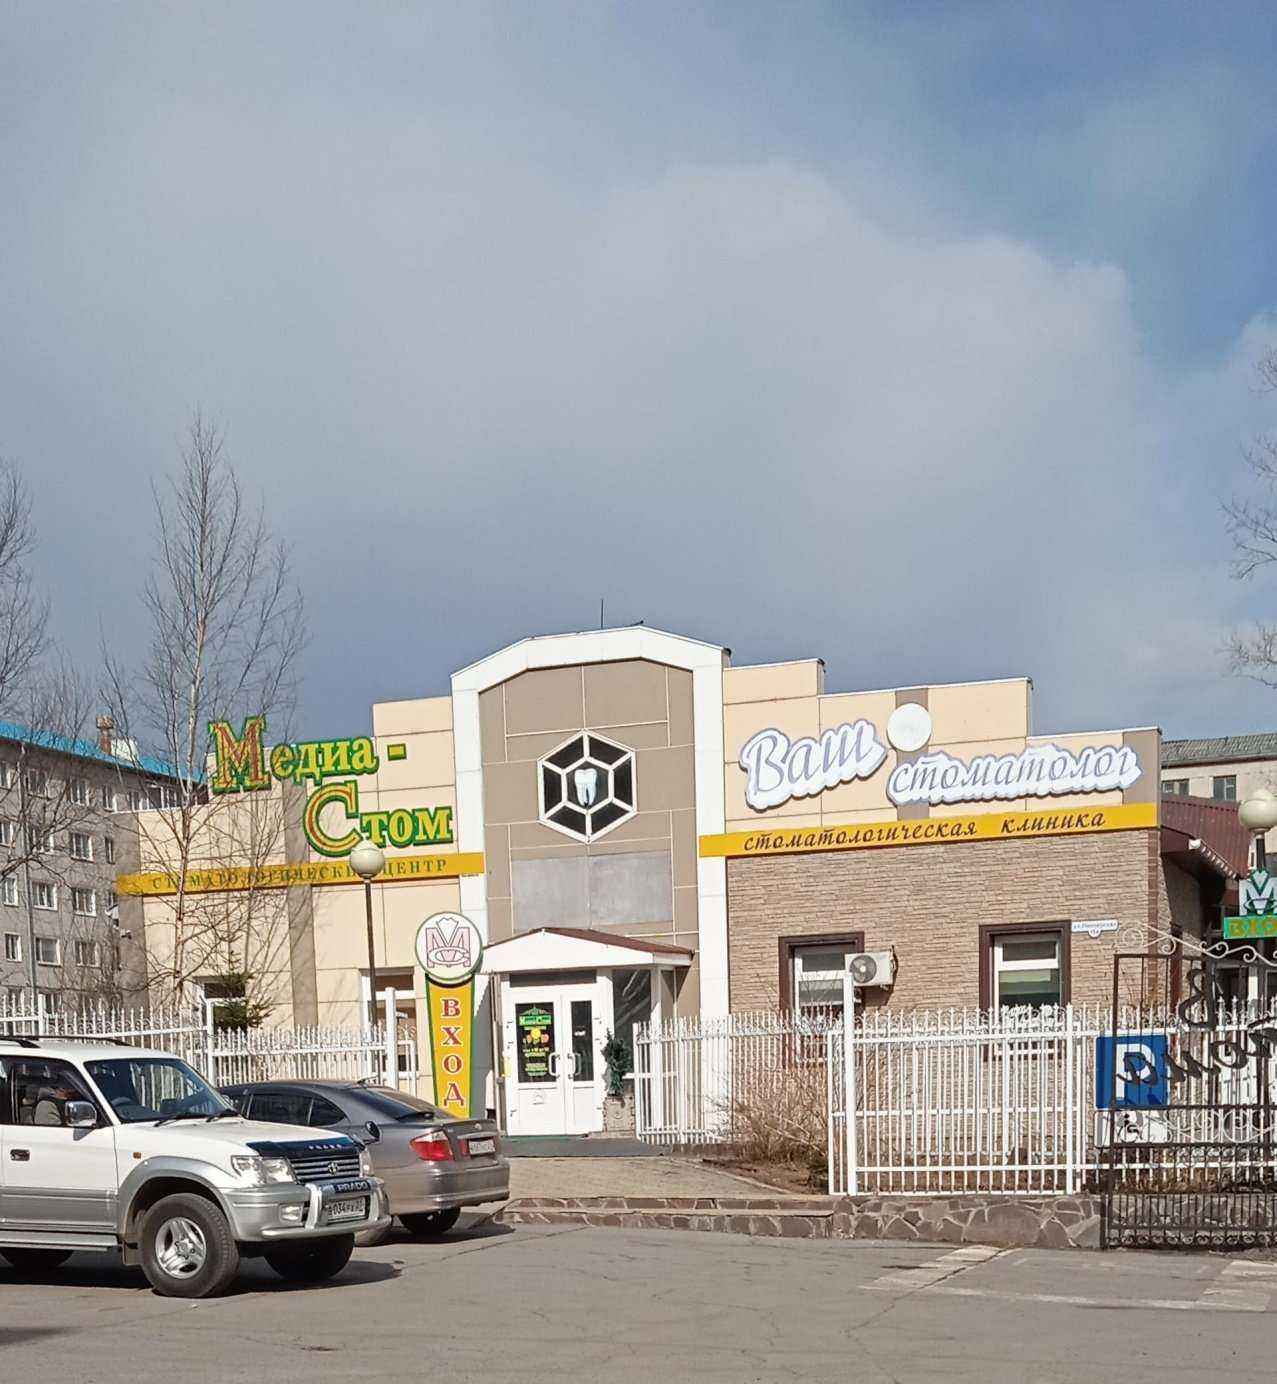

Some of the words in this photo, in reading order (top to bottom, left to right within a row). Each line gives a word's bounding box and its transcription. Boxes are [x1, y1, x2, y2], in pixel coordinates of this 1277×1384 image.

[744, 721, 878, 800] Ваш
[890, 746, 1134, 796] стоматолог
[303, 780, 453, 857] Стом
[744, 820, 978, 851] стоматологическая
[1000, 812, 1106, 834] клиника
[380, 858, 448, 878] ЦЕНТР
[440, 997, 465, 1108] ВХОД
[337, 1181, 368, 1193] PRADO
